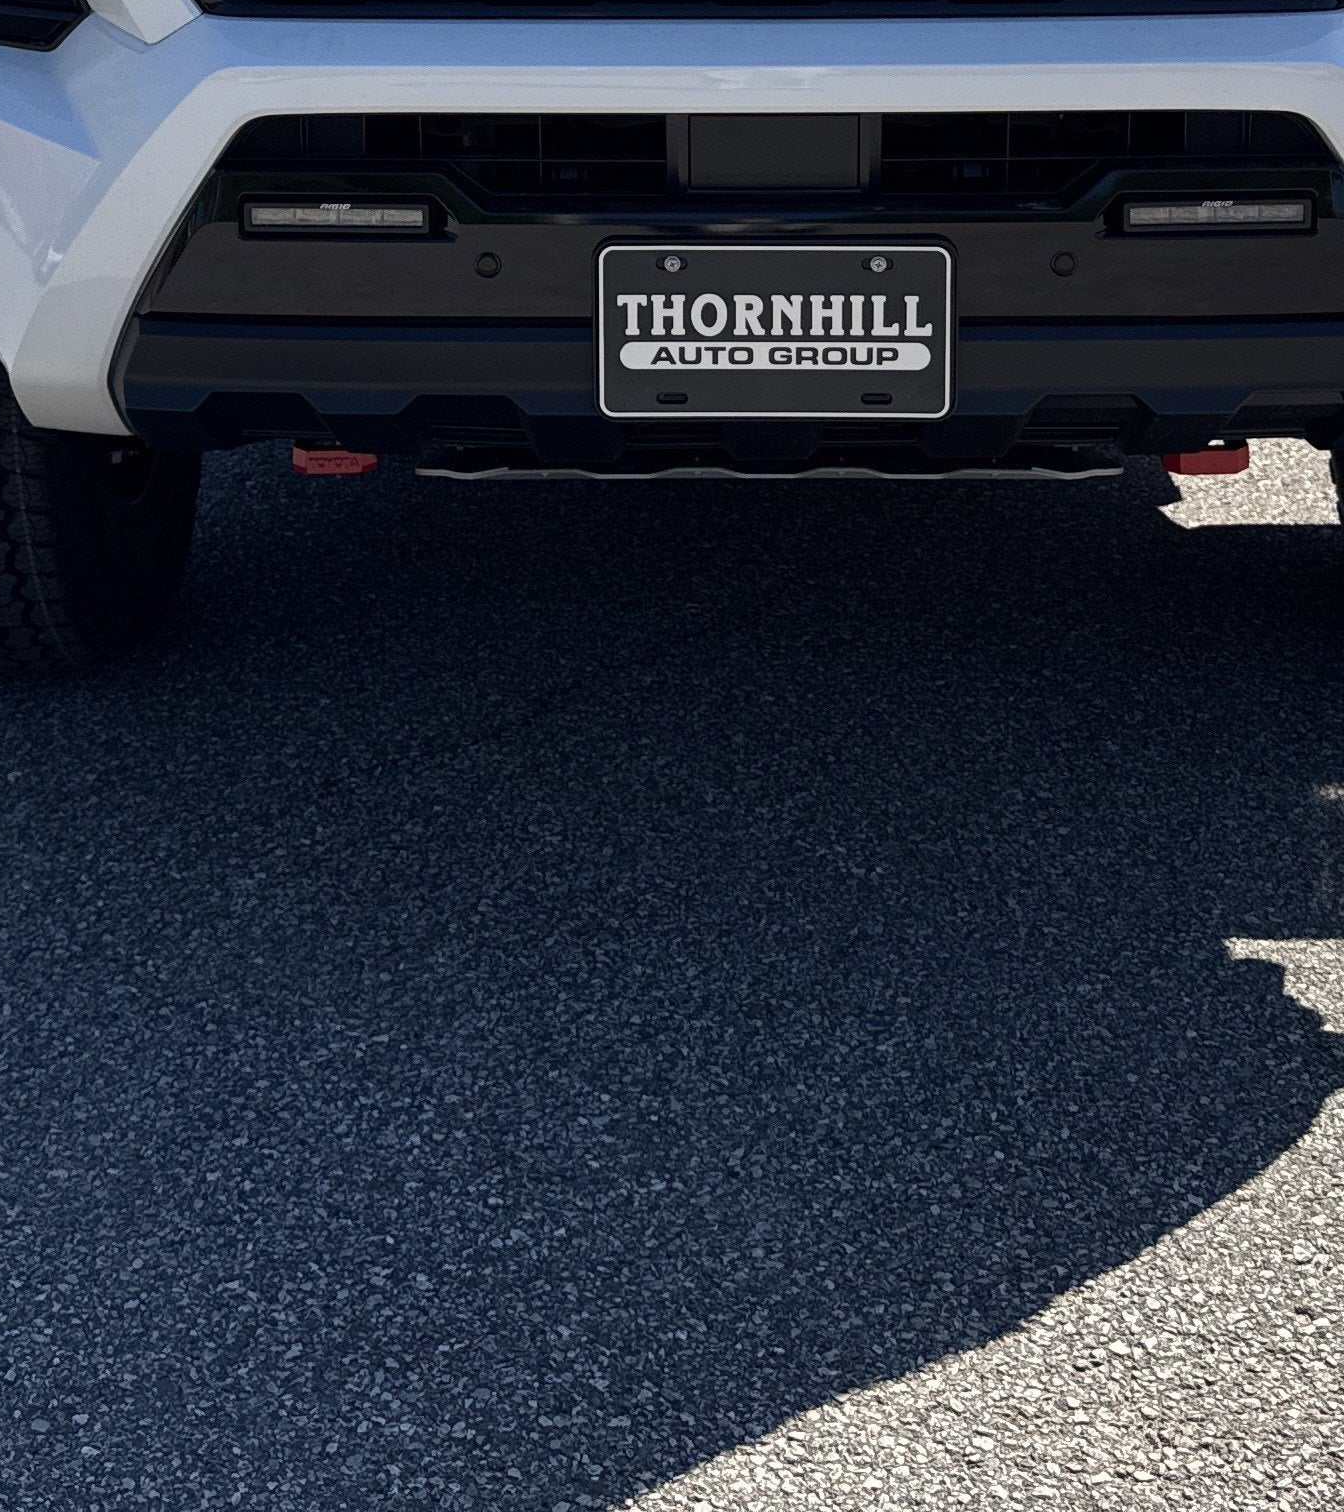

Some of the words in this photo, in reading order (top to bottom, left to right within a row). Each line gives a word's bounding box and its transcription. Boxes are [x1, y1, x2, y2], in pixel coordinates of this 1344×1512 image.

[617, 293, 933, 337] THORNHILL
[650, 346, 754, 365] AUTO
[768, 346, 899, 366] GROUP
